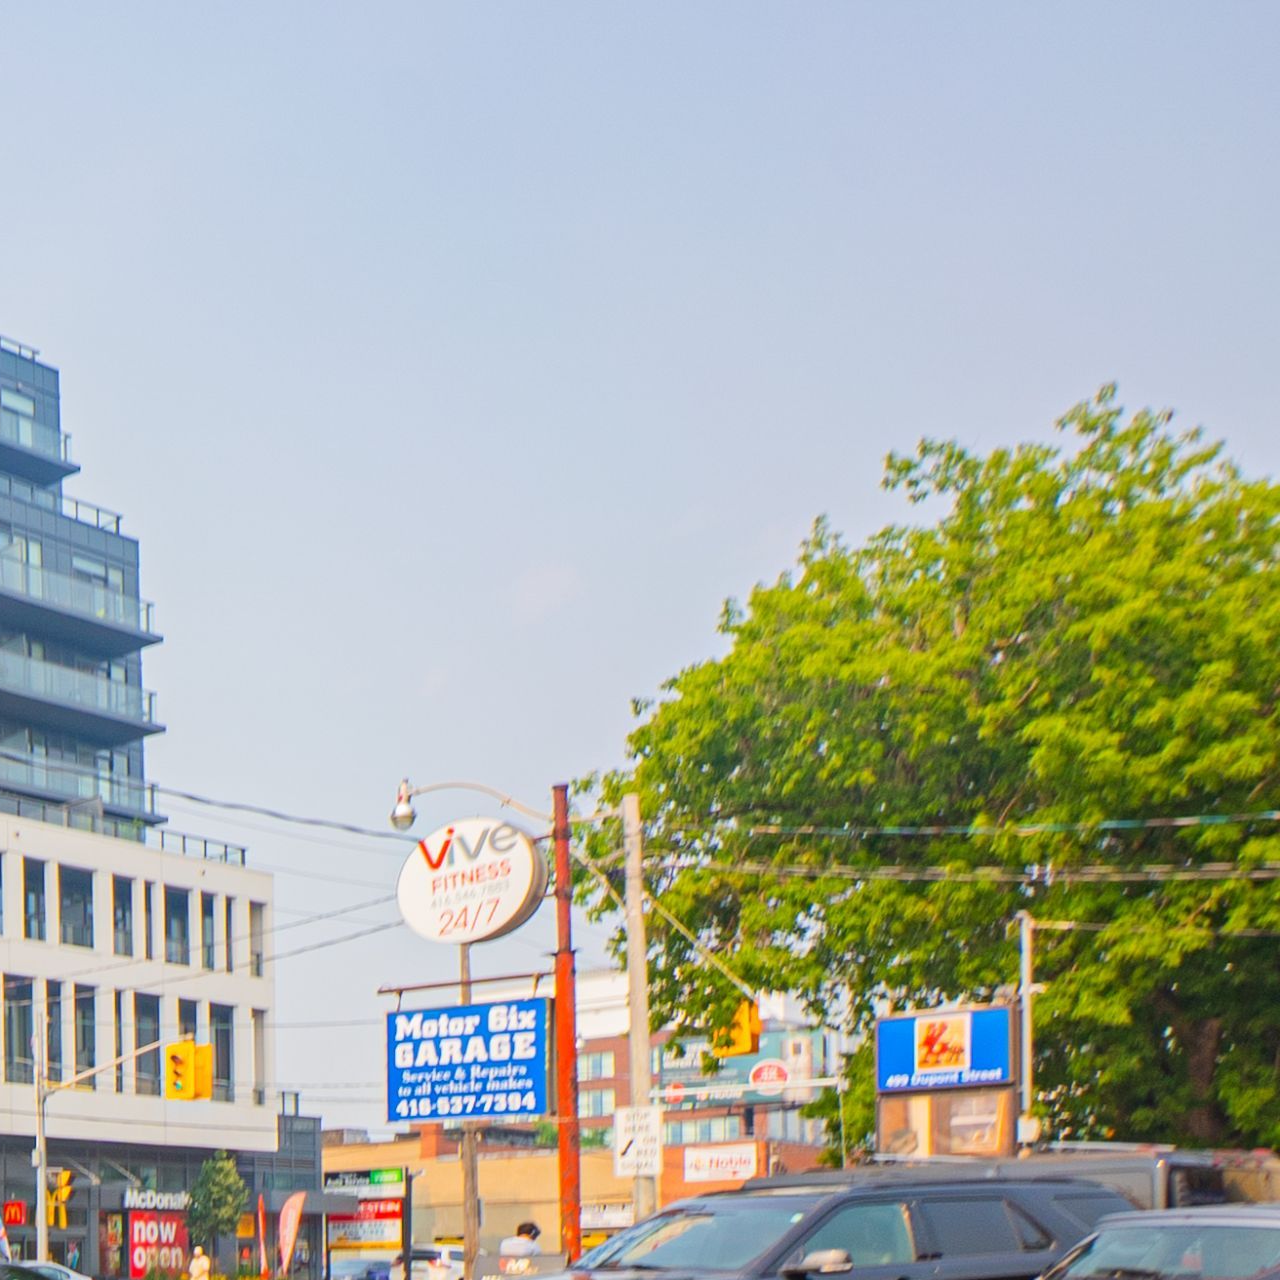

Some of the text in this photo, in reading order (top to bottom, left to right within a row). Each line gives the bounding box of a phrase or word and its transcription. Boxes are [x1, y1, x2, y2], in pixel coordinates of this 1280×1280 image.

[432, 859, 512, 895] FITNESS
[439, 897, 501, 936] 24/7
[394, 1013, 481, 1041] Motor
[394, 1031, 537, 1069] GARAGE
[402, 1067, 452, 1084] Service
[470, 1062, 528, 1080] Repairs
[910, 1071, 960, 1087] Dupont
[961, 1066, 1003, 1083] Street
[397, 1076, 534, 1098] to all vehicle makes
[124, 1186, 192, 1210] McDonal
[133, 1220, 177, 1244] now
[133, 1245, 184, 1271] open
